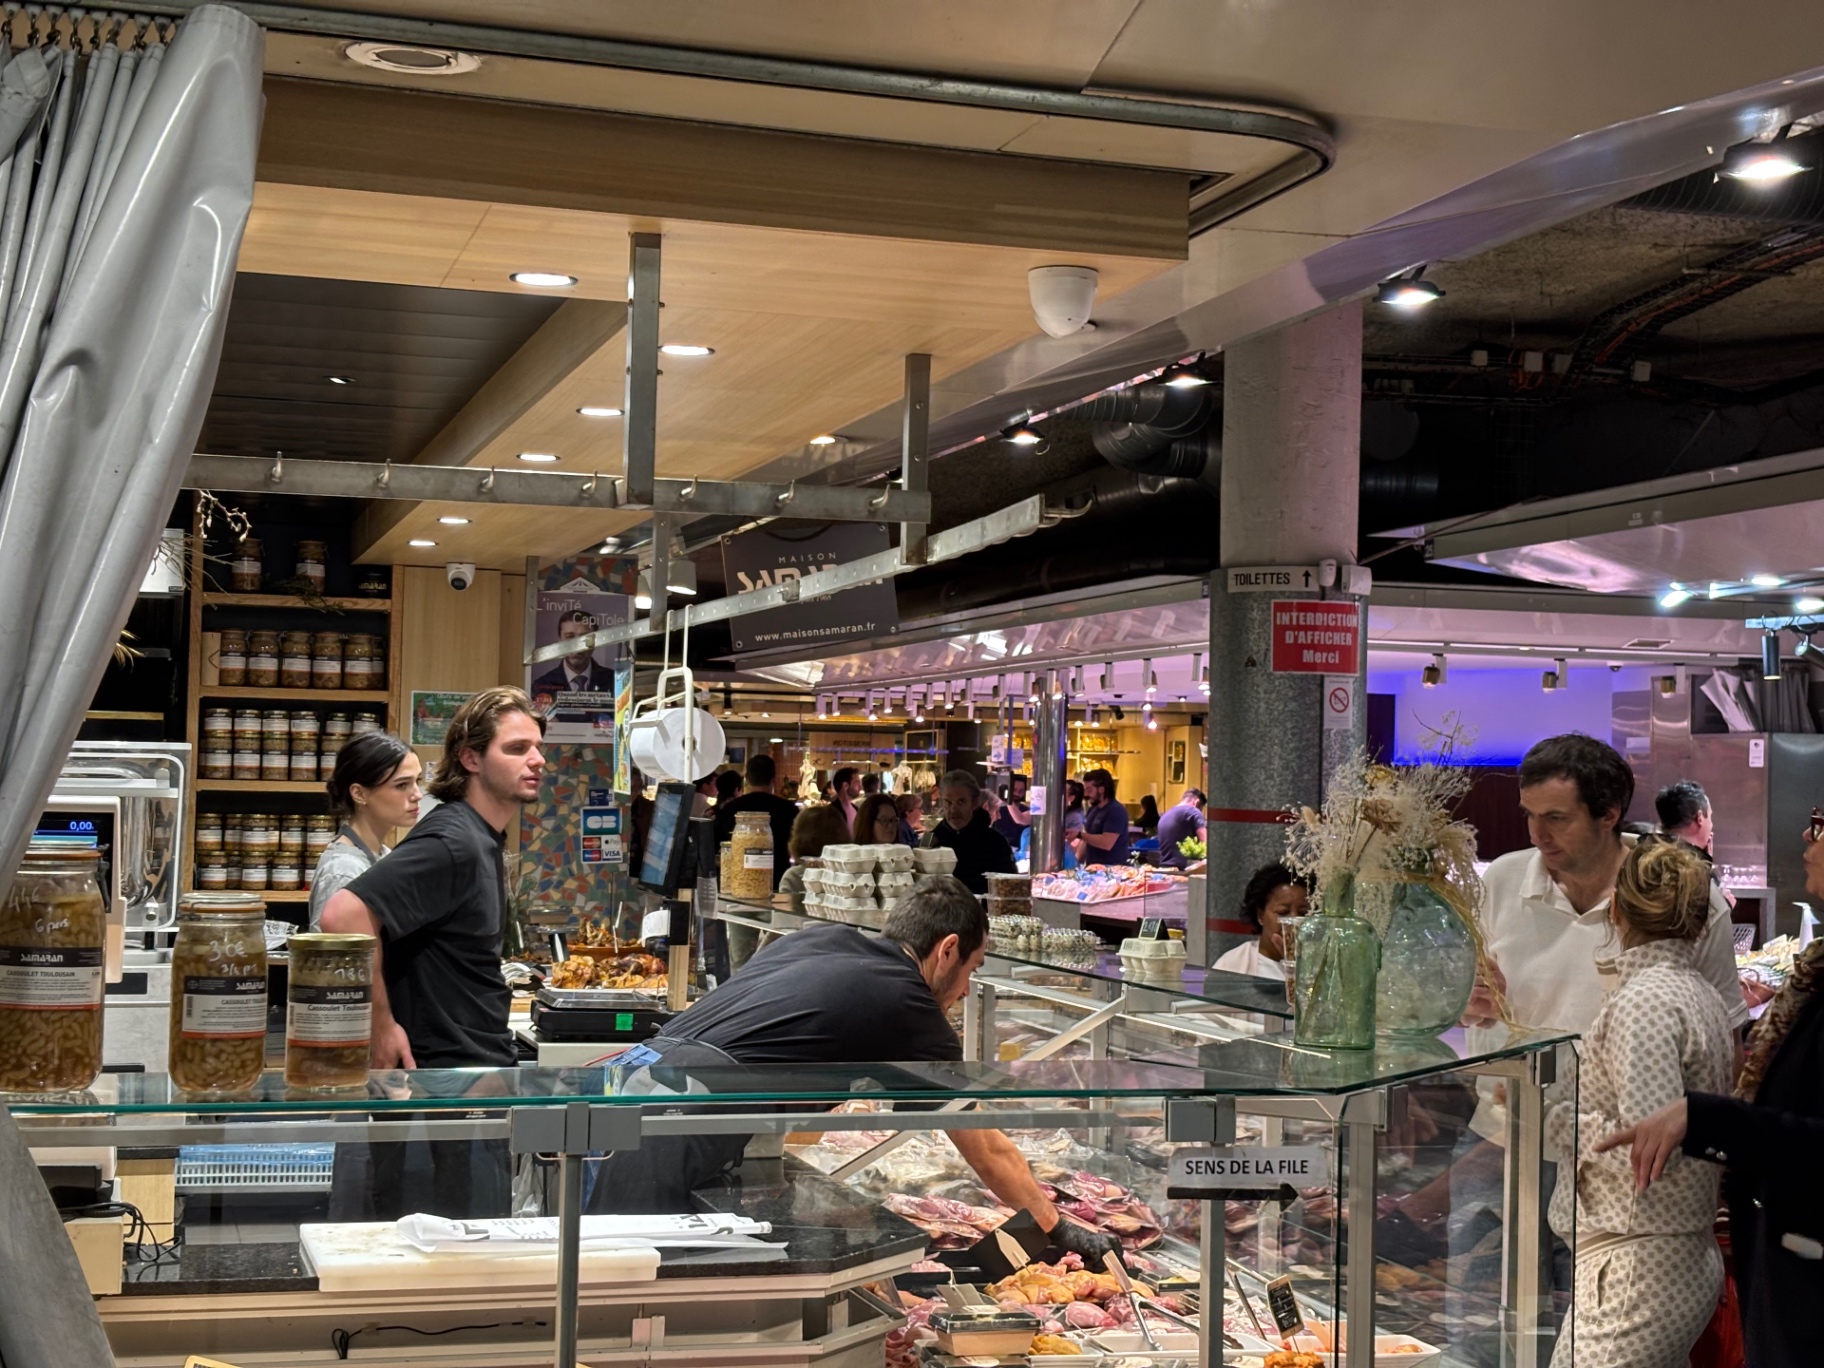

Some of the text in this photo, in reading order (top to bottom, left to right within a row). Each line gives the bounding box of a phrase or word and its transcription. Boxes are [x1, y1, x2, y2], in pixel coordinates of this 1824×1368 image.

[778, 552, 837, 564] MAISON
[1234, 572, 1291, 586] TOILETTES
[1276, 612, 1358, 628] INTERDICTION
[755, 622, 876, 642] www.maisonsamaran.fr
[1285, 630, 1353, 646] D'AFFICHER
[1302, 650, 1340, 664] Merci
[20, 953, 64, 963] SAMARAN
[1185, 1159, 1309, 1175] SENS DE LA FILE
